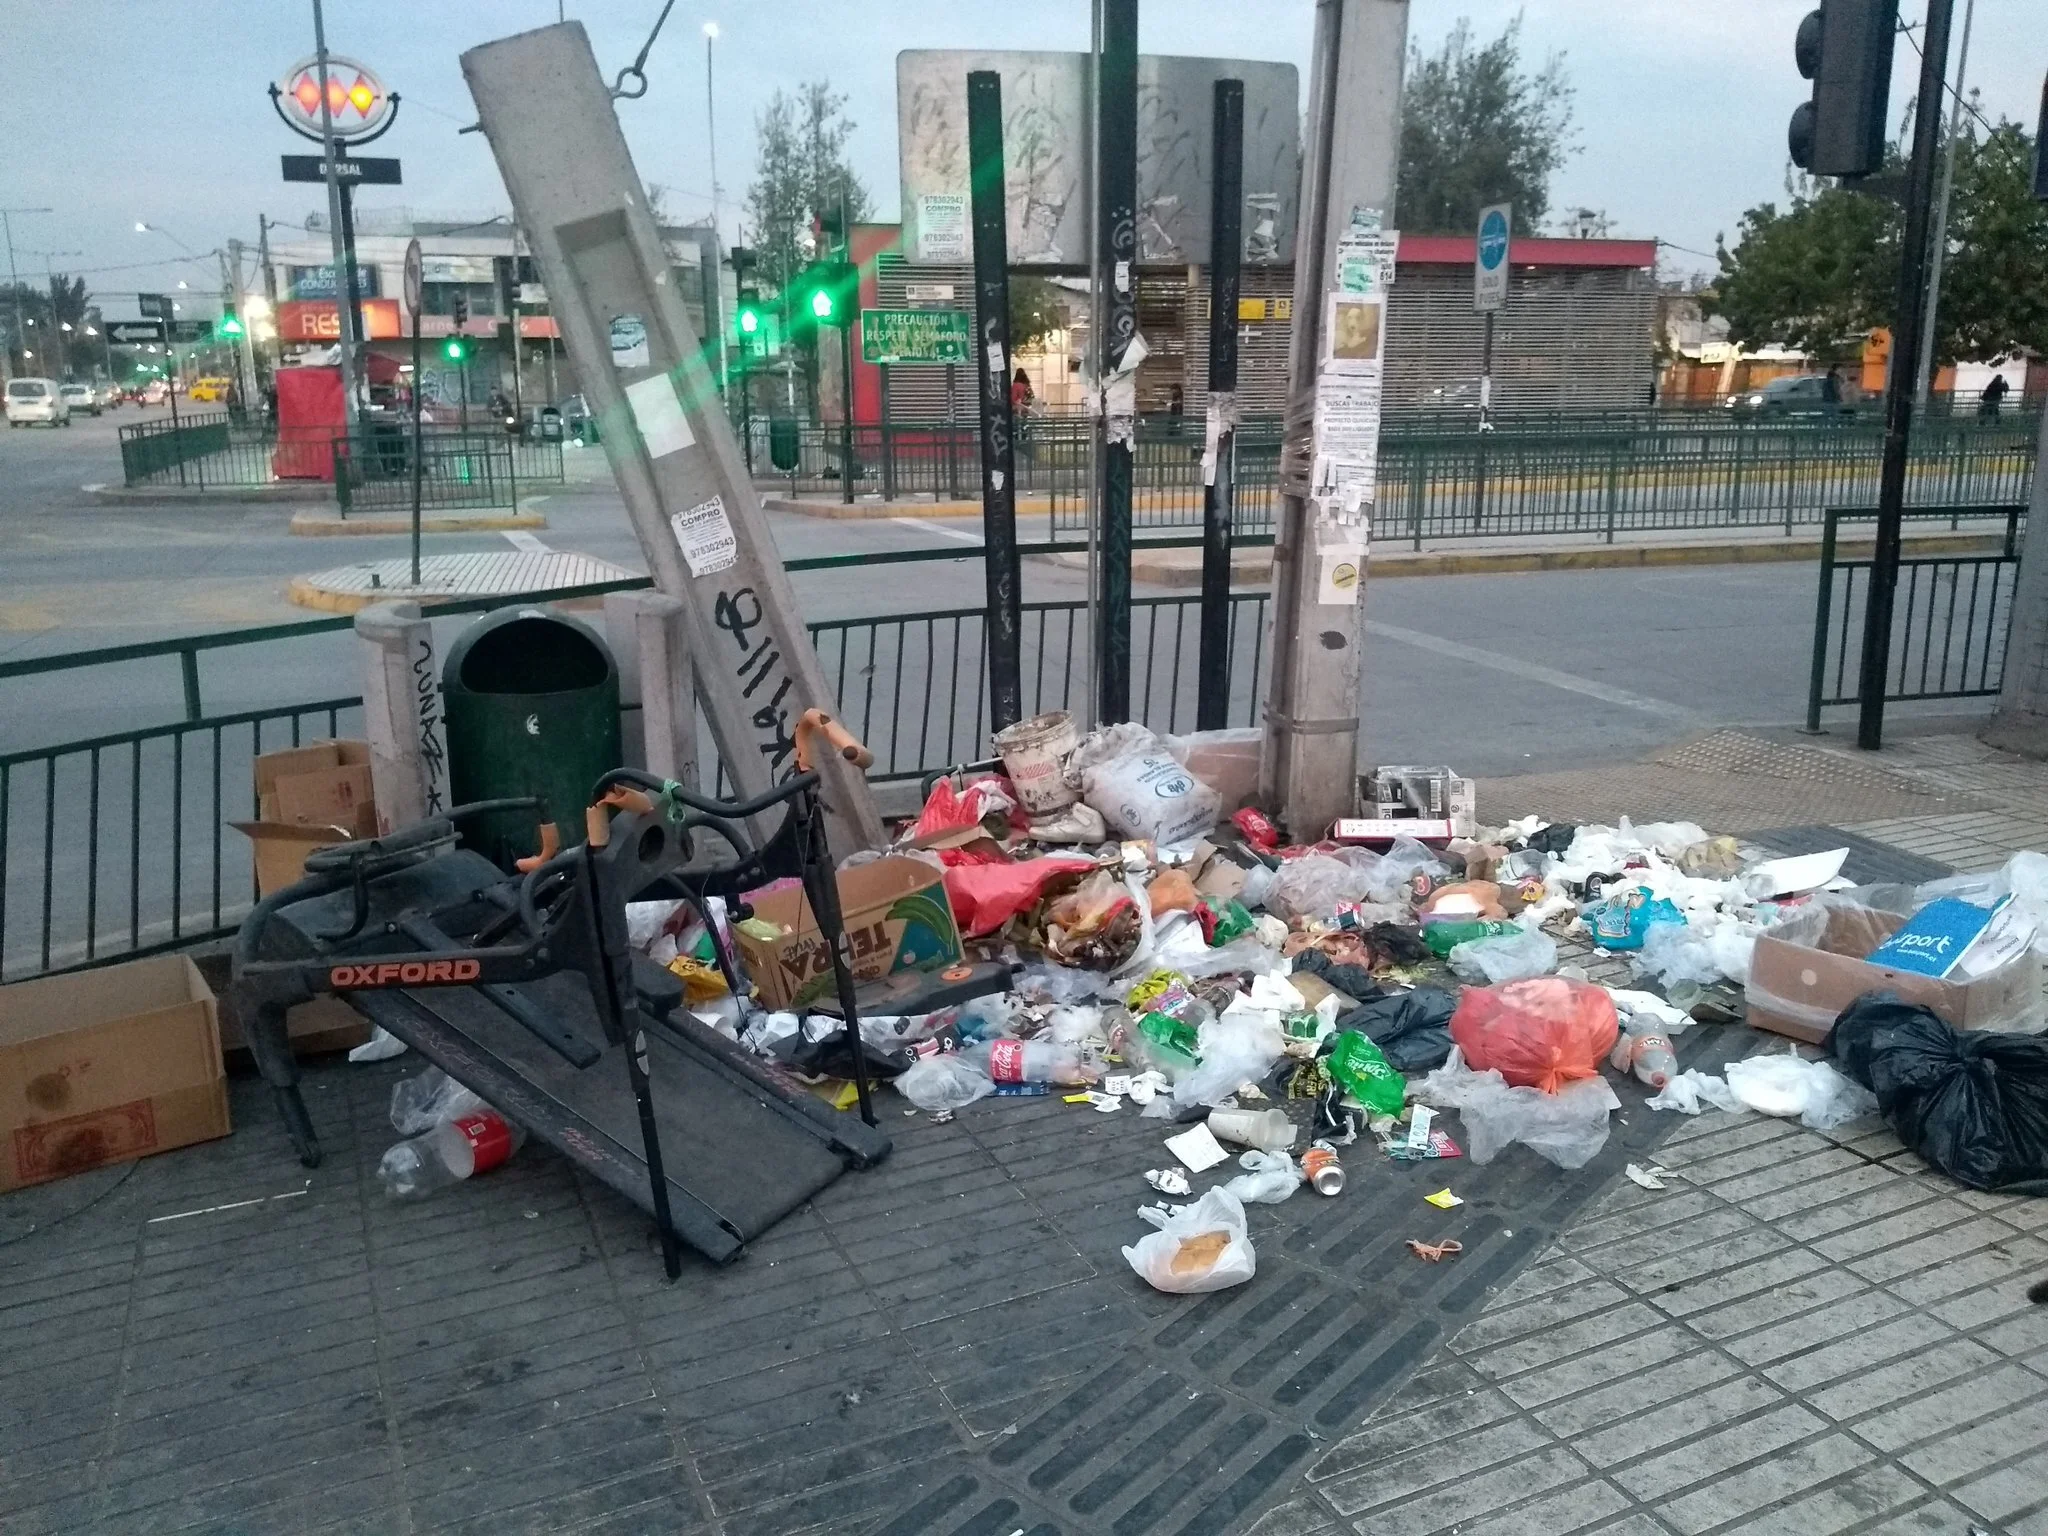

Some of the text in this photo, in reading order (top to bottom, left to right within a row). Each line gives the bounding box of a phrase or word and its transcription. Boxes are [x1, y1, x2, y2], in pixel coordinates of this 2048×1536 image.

[866, 330, 907, 341] RESPETE
[681, 508, 721, 527] COMPRO
[690, 536, 735, 559] 978302943
[331, 959, 481, 987] OXFORD
